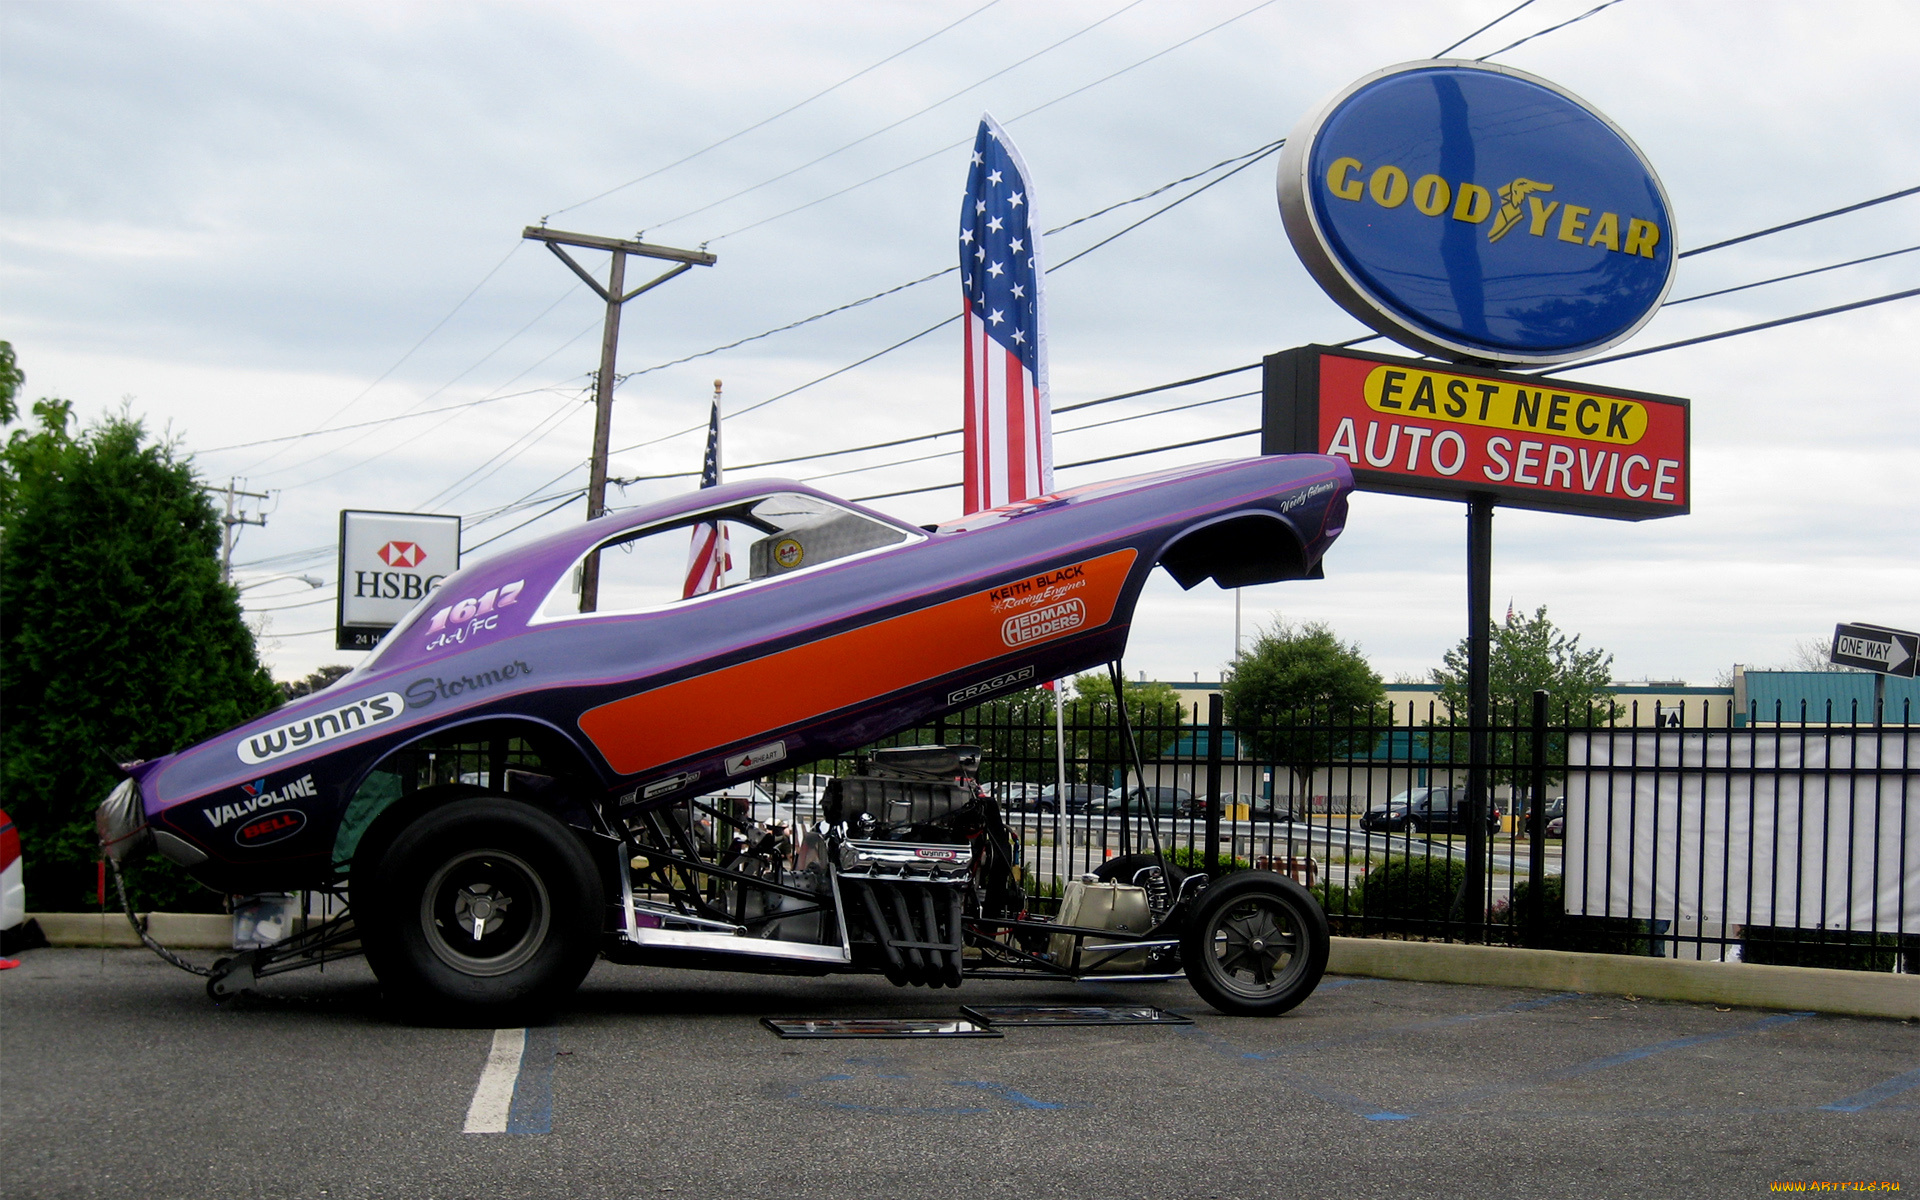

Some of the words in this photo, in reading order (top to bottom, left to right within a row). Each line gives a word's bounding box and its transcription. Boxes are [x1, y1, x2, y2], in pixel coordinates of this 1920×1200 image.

[1380, 371, 1499, 421] EAST
[1512, 390, 1633, 439] NECK
[1326, 417, 1466, 476] AUTO
[1482, 436, 1680, 501] SERVICE
[990, 580, 1032, 602] KEITH
[1036, 565, 1085, 588] BLACK
[1003, 597, 1045, 610] Racing
[1043, 579, 1086, 601] Engines
[425, 579, 525, 635] 1617
[355, 634, 368, 644] 24
[1840, 637, 1864, 656] ONE
[1866, 641, 1891, 661] WAY
[404, 660, 534, 709] Stormer
[951, 669, 1031, 702] CRAGAR
[202, 773, 318, 829] VALVOLINE
[243, 814, 299, 839] BELL
